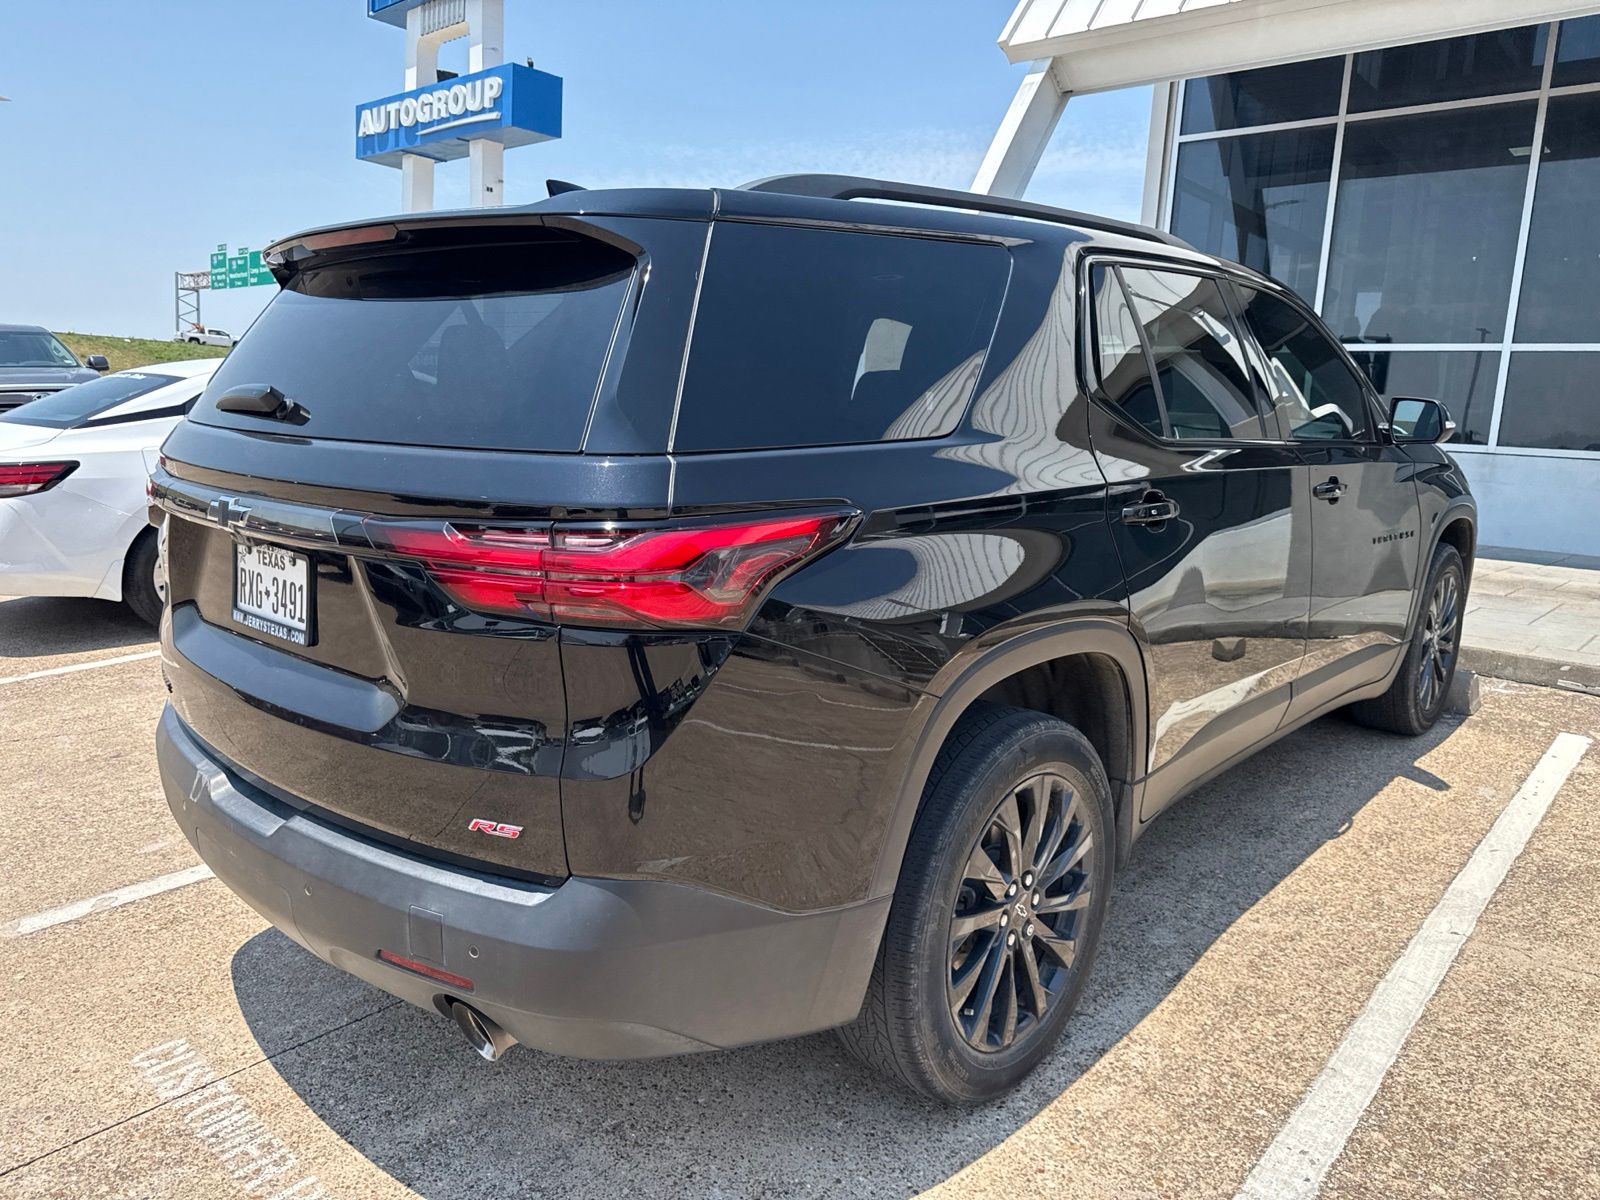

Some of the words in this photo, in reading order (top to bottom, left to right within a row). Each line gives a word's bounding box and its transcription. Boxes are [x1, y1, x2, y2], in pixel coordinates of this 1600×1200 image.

[358, 76, 502, 137] AUTOGROUP
[256, 550, 285, 571] TEXAS
[240, 567, 263, 609] RXG
[272, 577, 305, 623] 3491
[468, 818, 524, 839] RS
